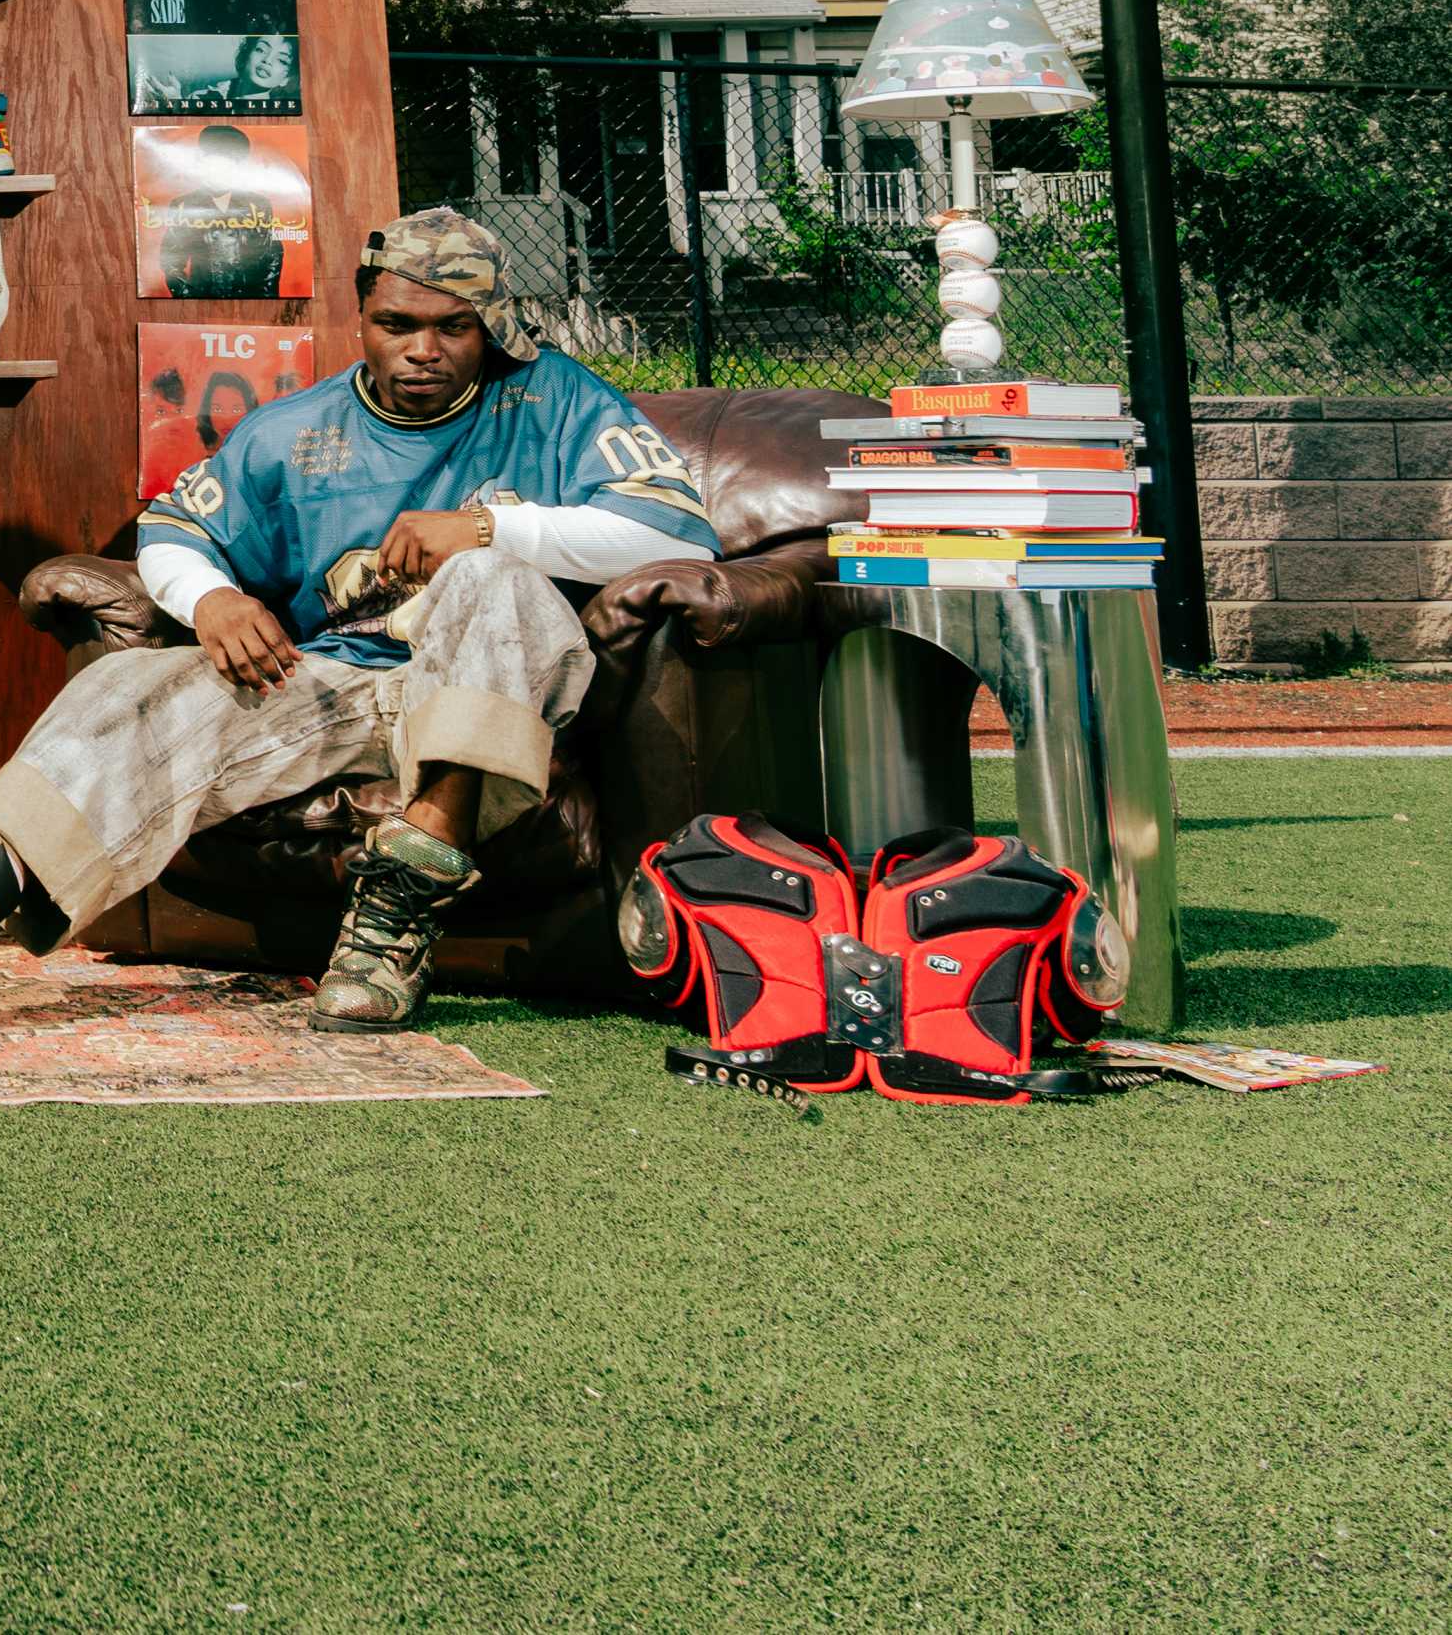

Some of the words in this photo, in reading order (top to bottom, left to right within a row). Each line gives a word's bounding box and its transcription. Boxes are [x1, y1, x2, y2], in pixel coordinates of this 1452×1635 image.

[248, 100, 296, 109] LIFE
[272, 228, 309, 243] kollage
[200, 333, 256, 359] TLC
[911, 389, 992, 416] Basquiat
[860, 452, 907, 464] DRAGON
[908, 451, 937, 464] BALL
[856, 541, 885, 552] POP
